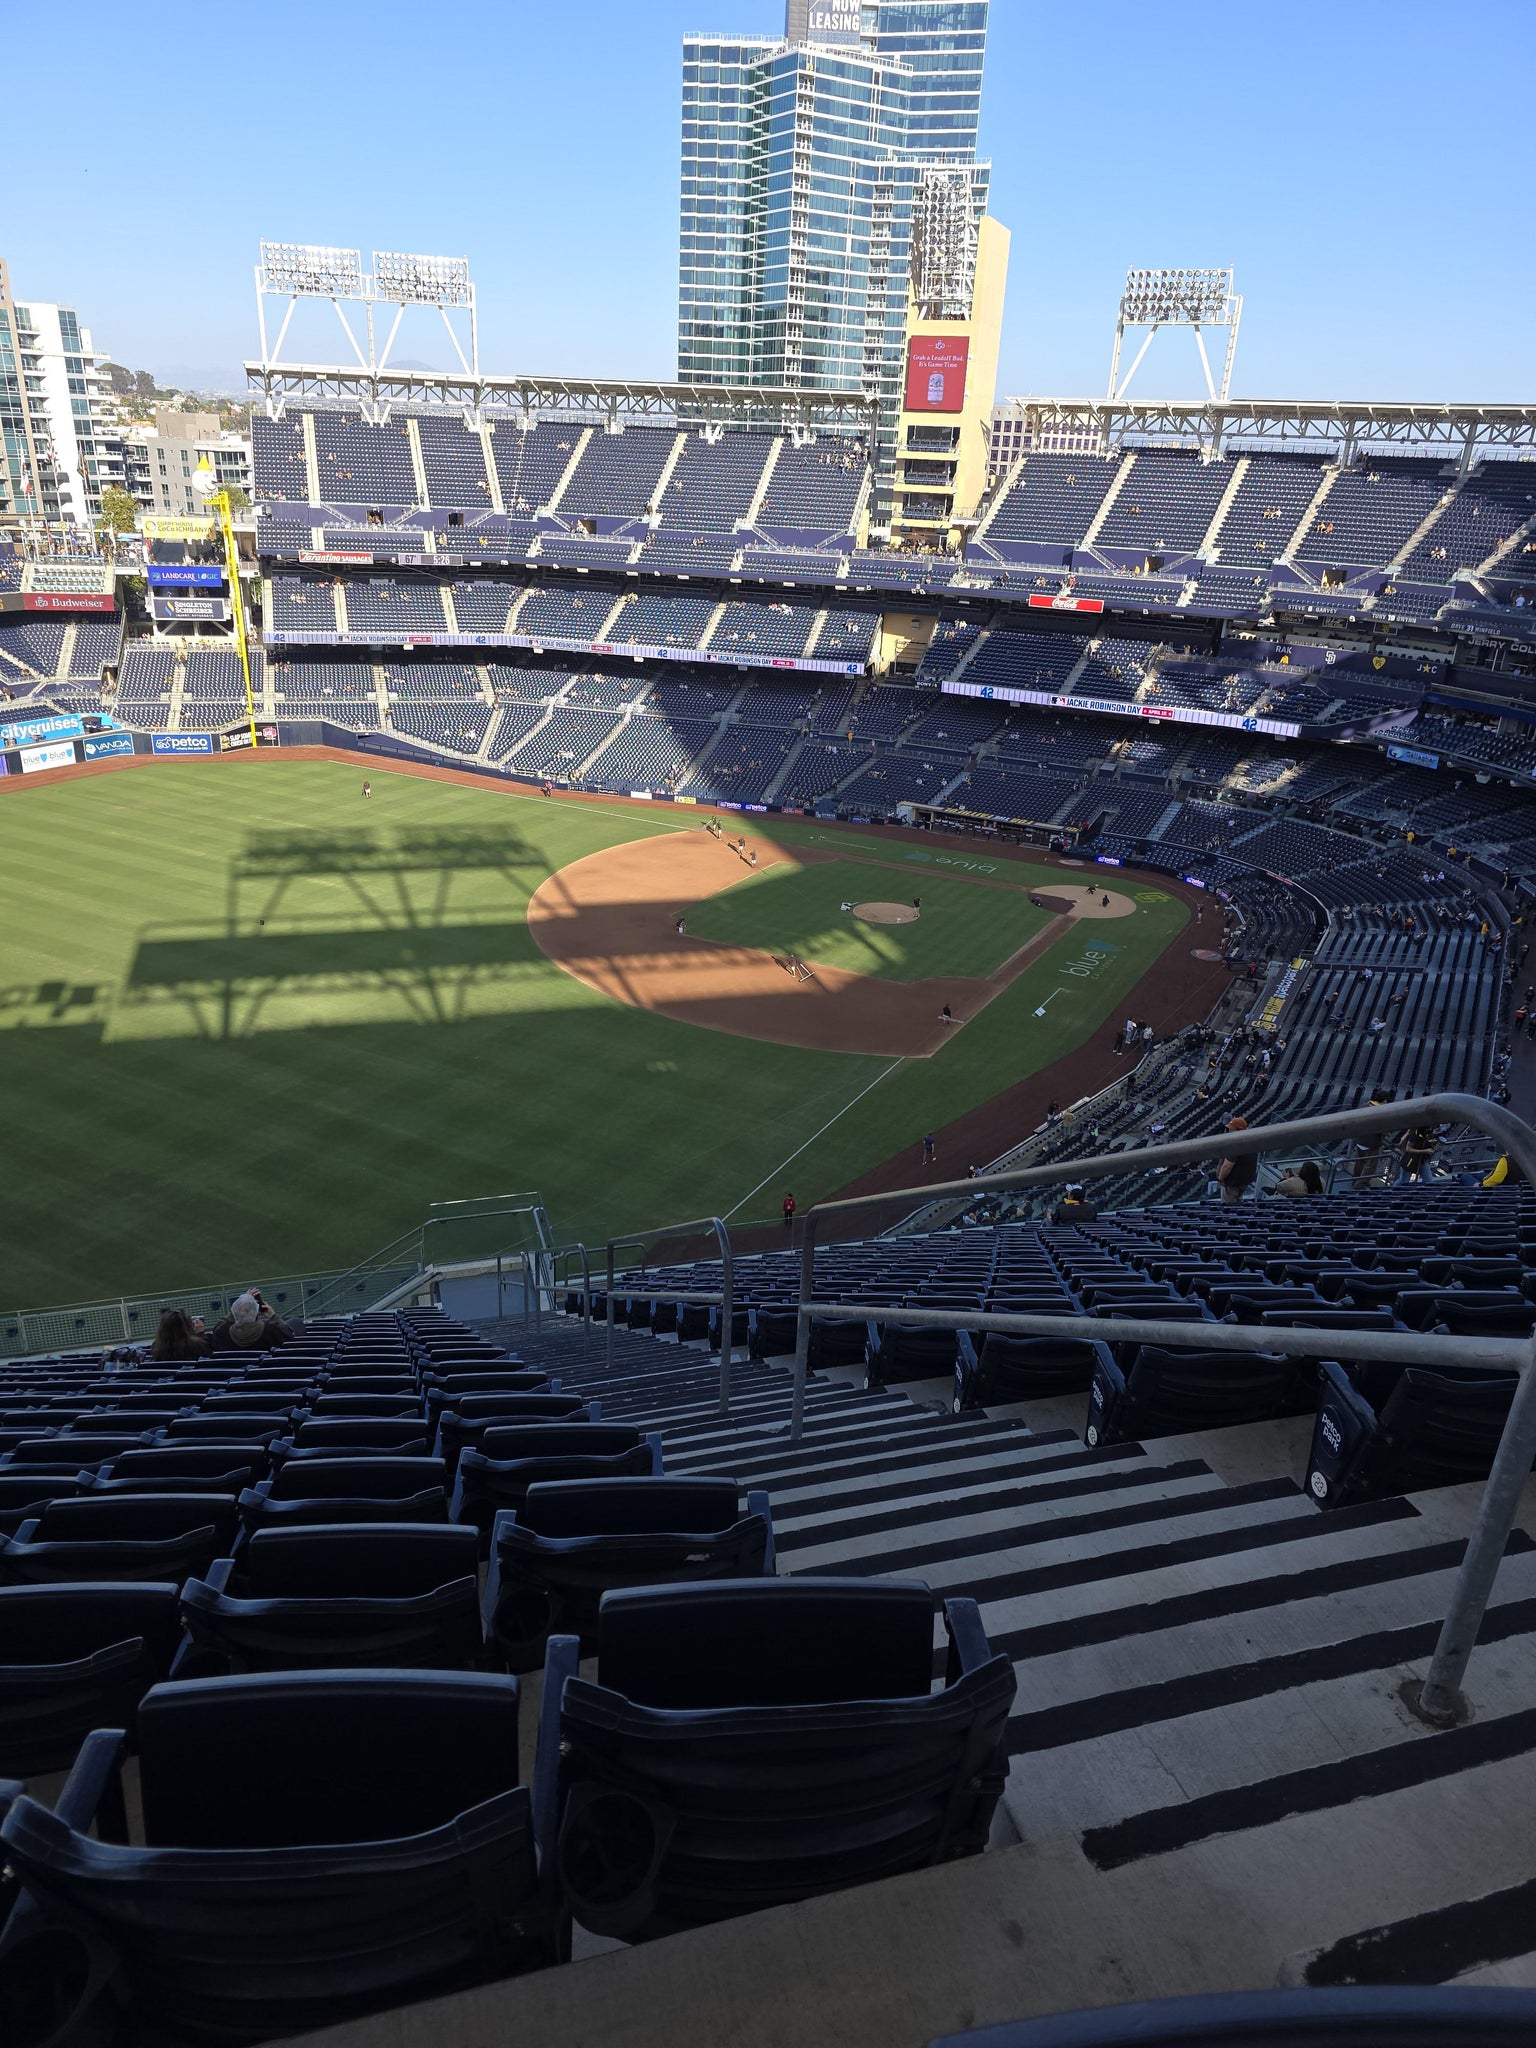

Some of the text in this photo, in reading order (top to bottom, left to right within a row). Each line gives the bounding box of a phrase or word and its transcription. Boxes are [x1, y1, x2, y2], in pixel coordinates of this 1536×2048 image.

[832, 0, 860, 12] NOW
[809, 13, 860, 31] LEASING
[300, 552, 373, 563] Tarantino SAUSAGES
[433, 555, 450, 565] 5:26
[52, 598, 104, 608] Budweiser
[1474, 626, 1501, 635] WINFIELD
[273, 633, 286, 642] 42
[475, 636, 486, 644] 42
[1468, 638, 1506, 649] JERRY
[1510, 643, 1536, 655] COL
[657, 650, 668, 658] 42
[1276, 645, 1293, 654] RAK
[718, 655, 734, 663] JACKIE
[734, 656, 761, 665] ROBINSON
[847, 664, 858, 673] 42
[980, 687, 994, 698] 42
[1066, 698, 1142, 714] JACKIE ROBINSON DAY
[1, 718, 78, 739] citycruises
[1242, 717, 1257, 730] 42
[230, 733, 241, 741] SLAP
[95, 740, 131, 751] VANDA
[172, 737, 208, 749] petco
[23, 751, 66, 764] blue blue
[1406, 751, 1437, 763] Gallagher
[726, 801, 767, 812] petco petco
[936, 856, 998, 874] blue
[1104, 857, 1120, 865] petco
[1059, 951, 1106, 977] blue
[1321, 1413, 1341, 1443] petco
[1323, 1426, 1339, 1452] park
